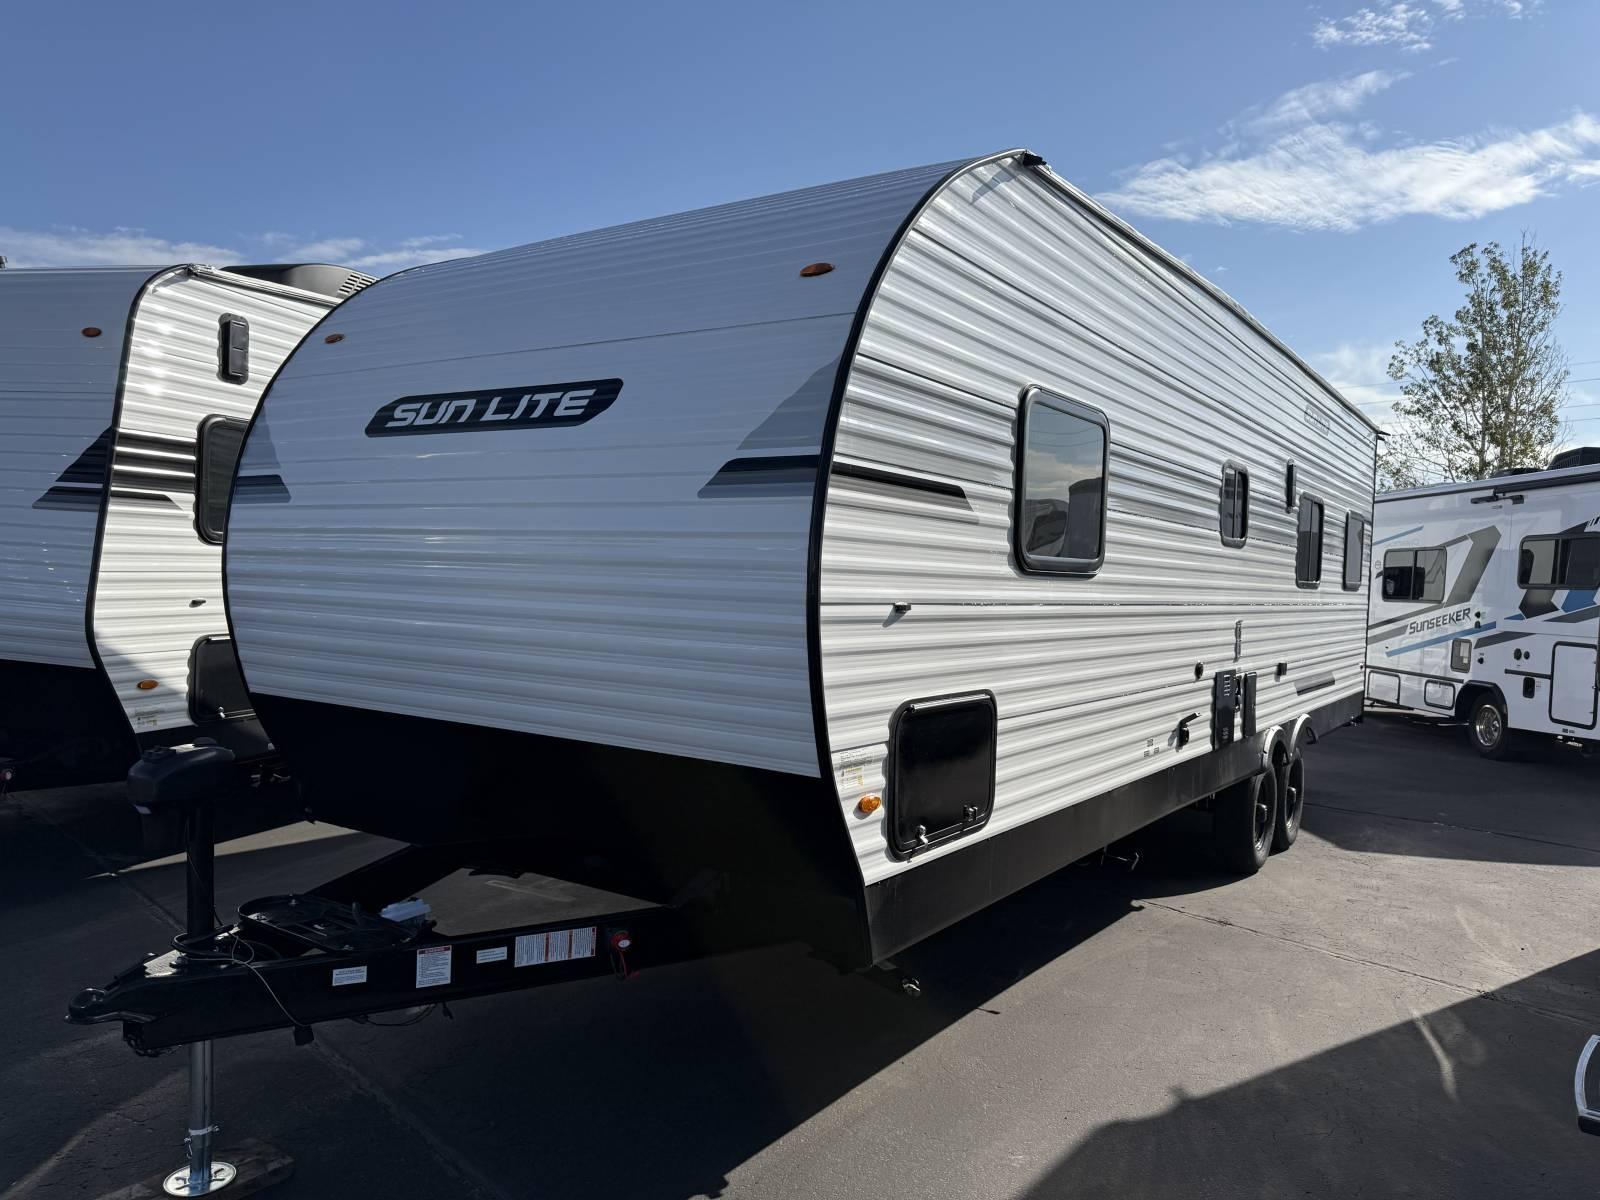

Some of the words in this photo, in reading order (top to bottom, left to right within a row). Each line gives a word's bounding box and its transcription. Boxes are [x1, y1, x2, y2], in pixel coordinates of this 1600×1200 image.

[385, 399, 477, 428] SUN
[479, 389, 597, 422] LITE
[1408, 607, 1472, 635] SUNSEEKER
